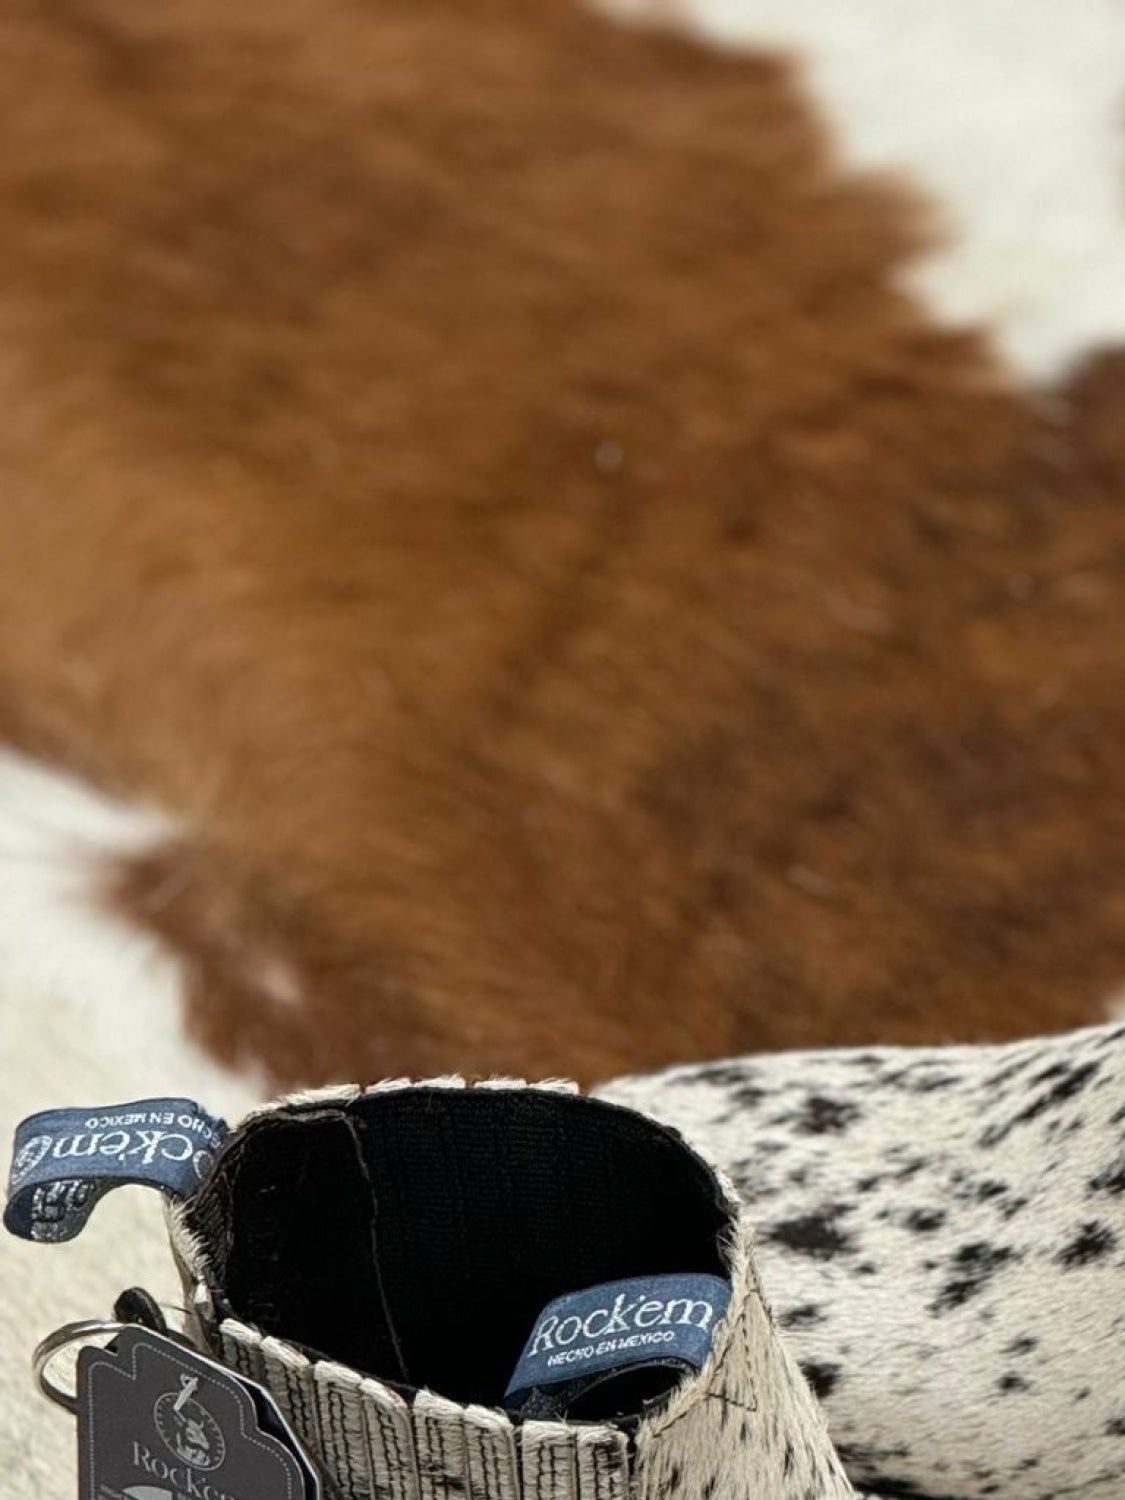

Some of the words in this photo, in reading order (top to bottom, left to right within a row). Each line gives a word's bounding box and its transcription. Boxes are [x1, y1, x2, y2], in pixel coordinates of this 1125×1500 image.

[85, 1112, 147, 1129] MEXICO
[149, 1112, 175, 1124] EN
[177, 1117, 224, 1149] ECHO
[547, 1345, 594, 1367] HECHO
[596, 1340, 618, 1355] EN
[618, 1331, 675, 1349] MEXICO
